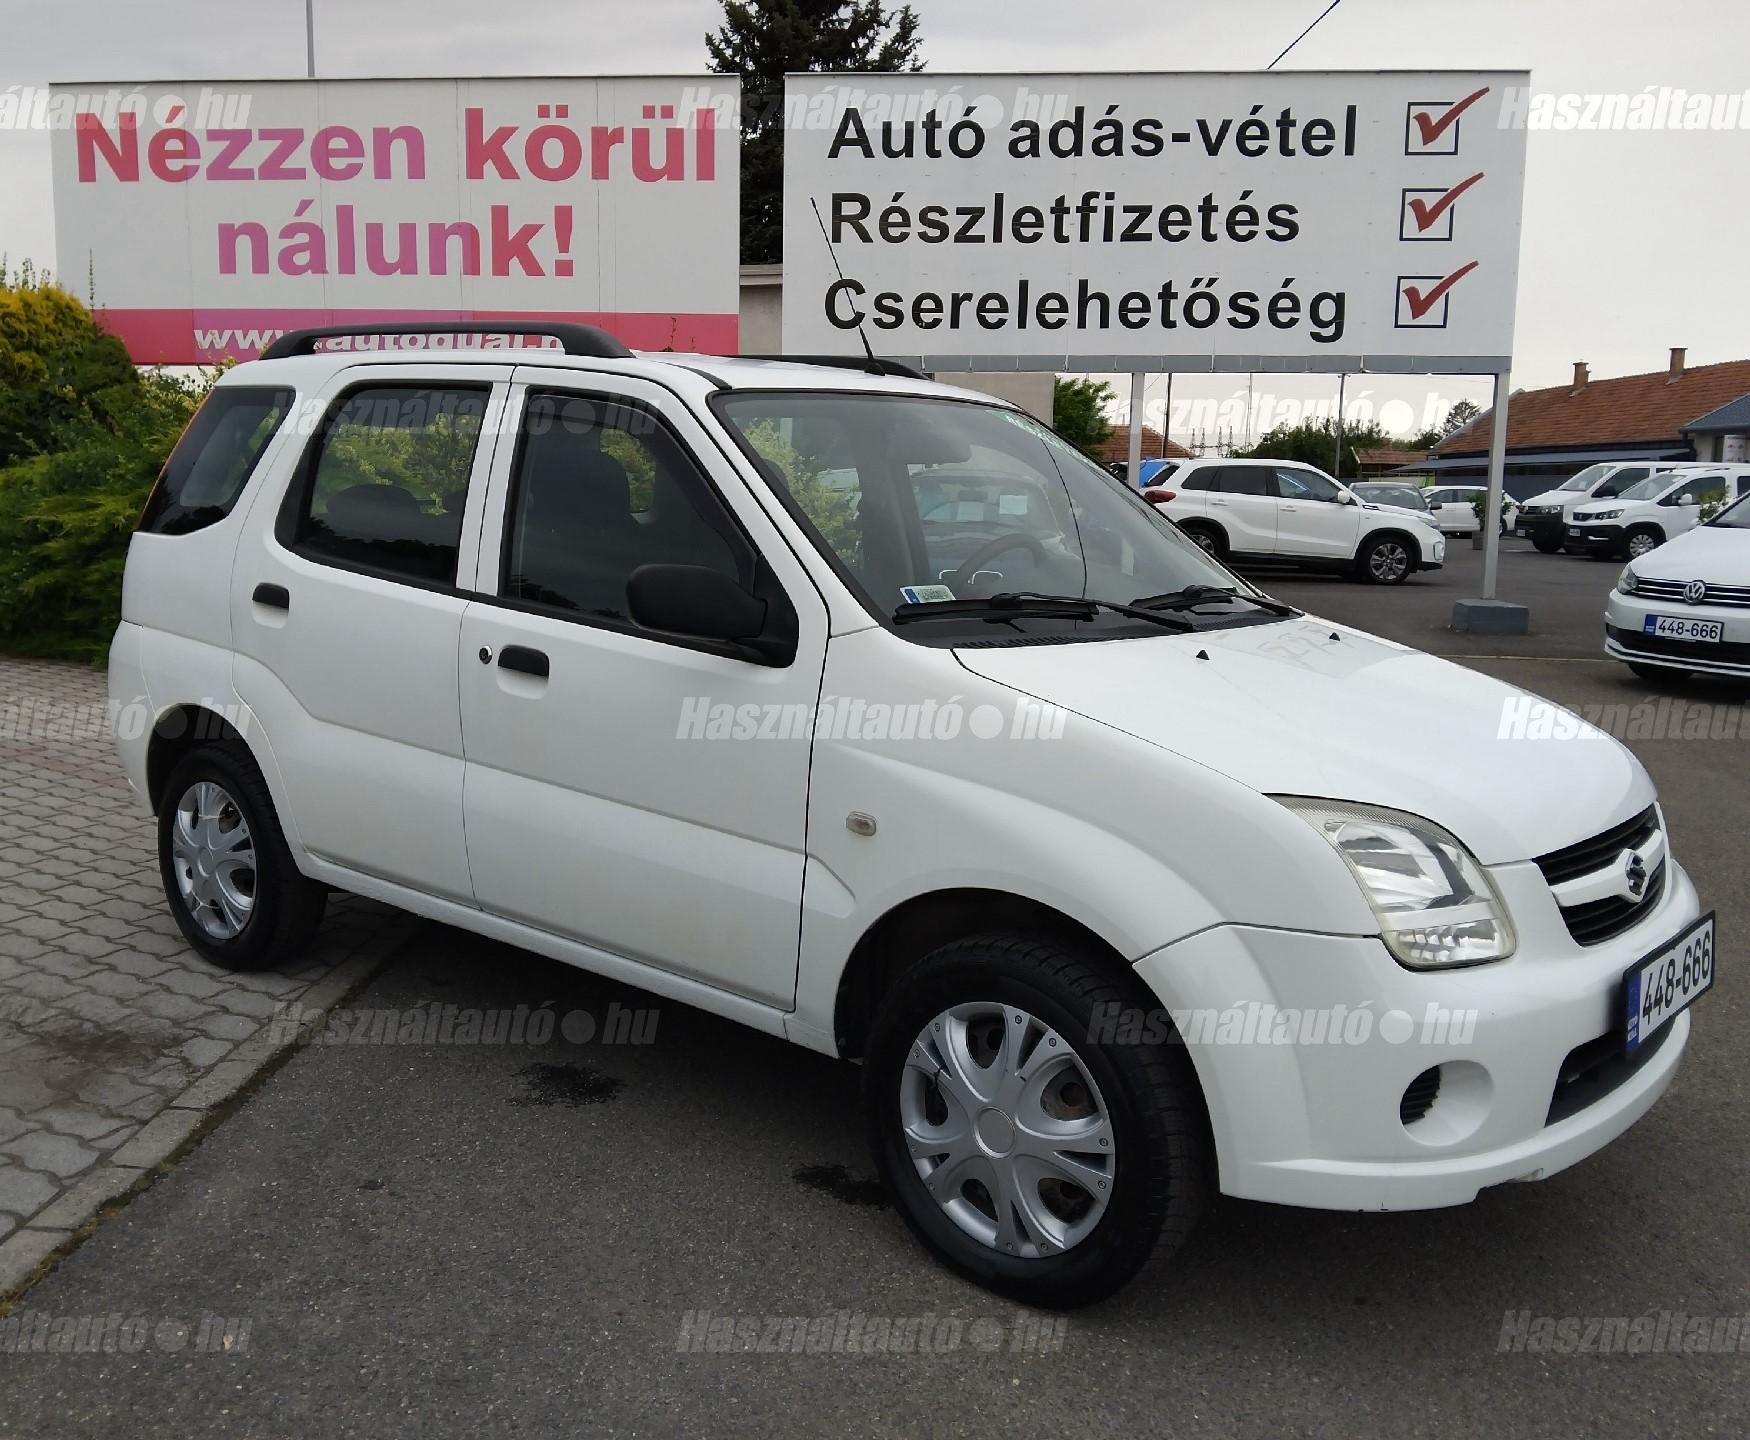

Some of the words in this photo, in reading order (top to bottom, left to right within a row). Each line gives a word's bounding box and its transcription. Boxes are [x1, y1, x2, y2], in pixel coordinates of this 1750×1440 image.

[75, 105, 427, 184] Nézzen
[464, 105, 716, 183] körül
[827, 105, 986, 159] Autó
[1007, 105, 1357, 159] adás-vétel
[217, 199, 574, 277] nálunk!
[830, 191, 1301, 244] Részletfizetés
[823, 278, 1347, 343] Cserelehetőség
[1657, 619, 1719, 639] 448-666
[1642, 930, 1711, 1025] 448-666
